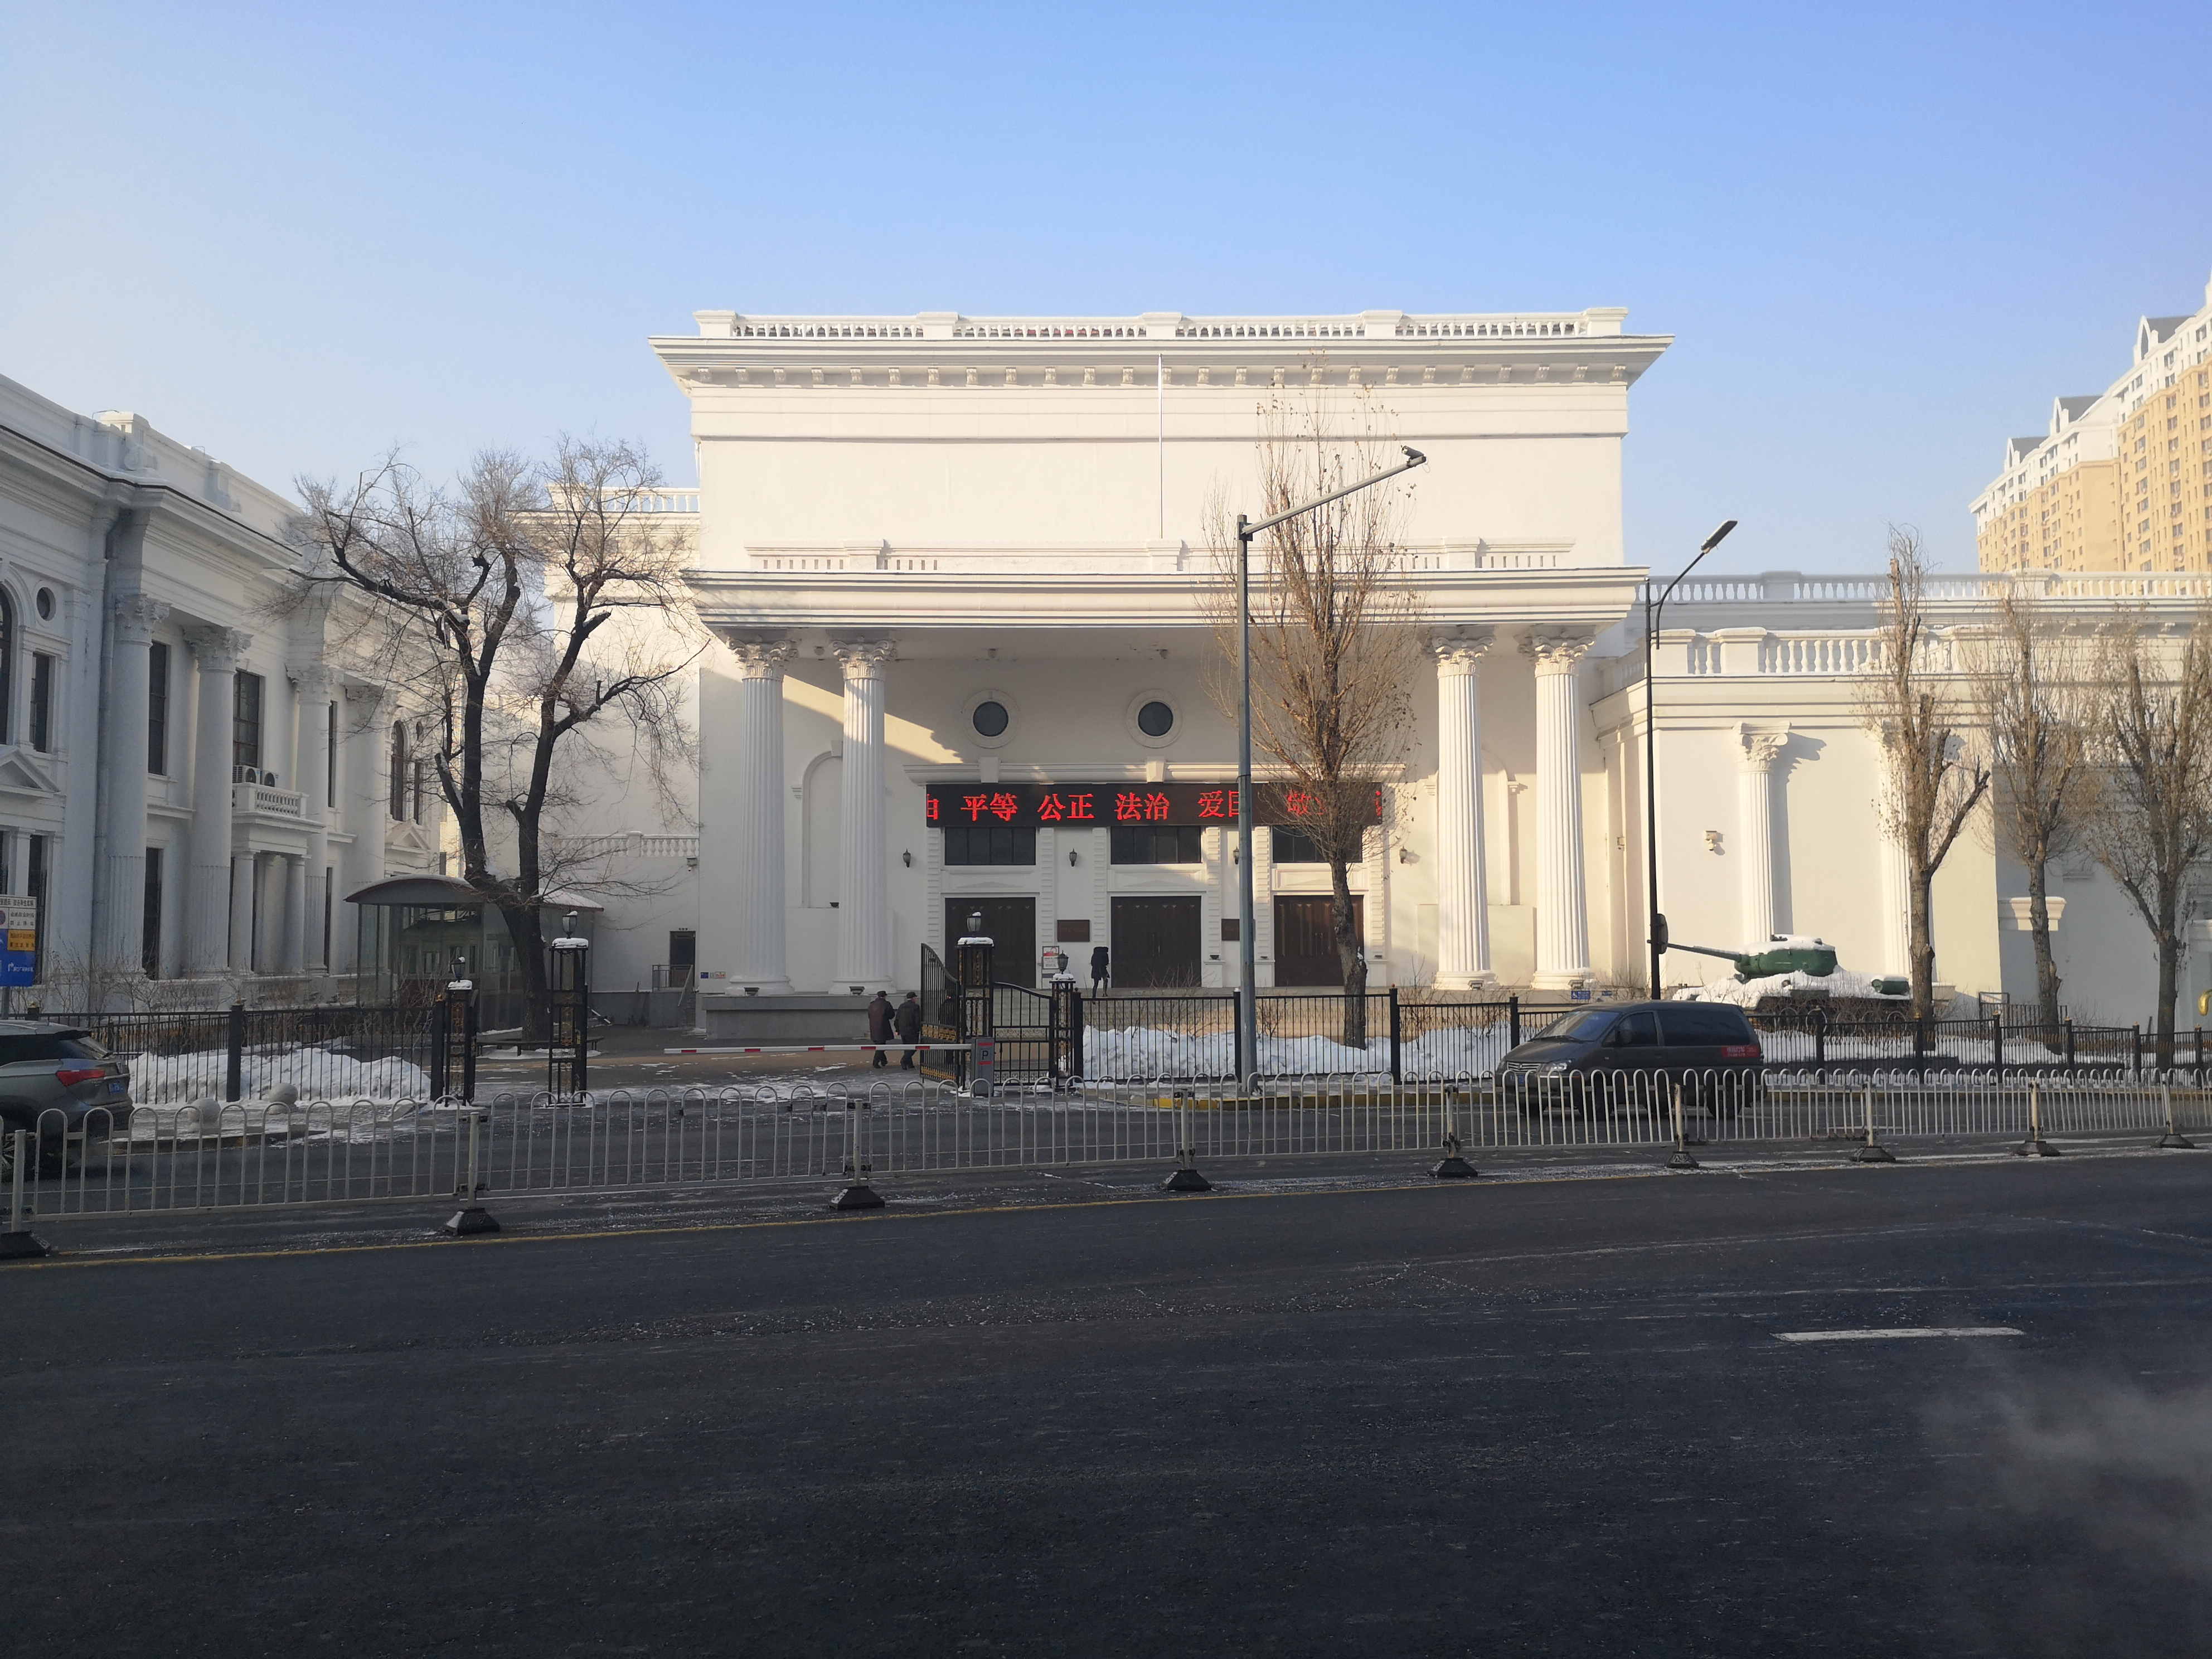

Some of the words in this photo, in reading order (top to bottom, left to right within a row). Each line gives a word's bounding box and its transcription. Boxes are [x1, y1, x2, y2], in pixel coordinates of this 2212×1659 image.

[961, 792, 1018, 822] 平等
[1037, 793, 1094, 821] 公正
[1114, 792, 1170, 821] 法治
[982, 1050, 988, 1060] P
